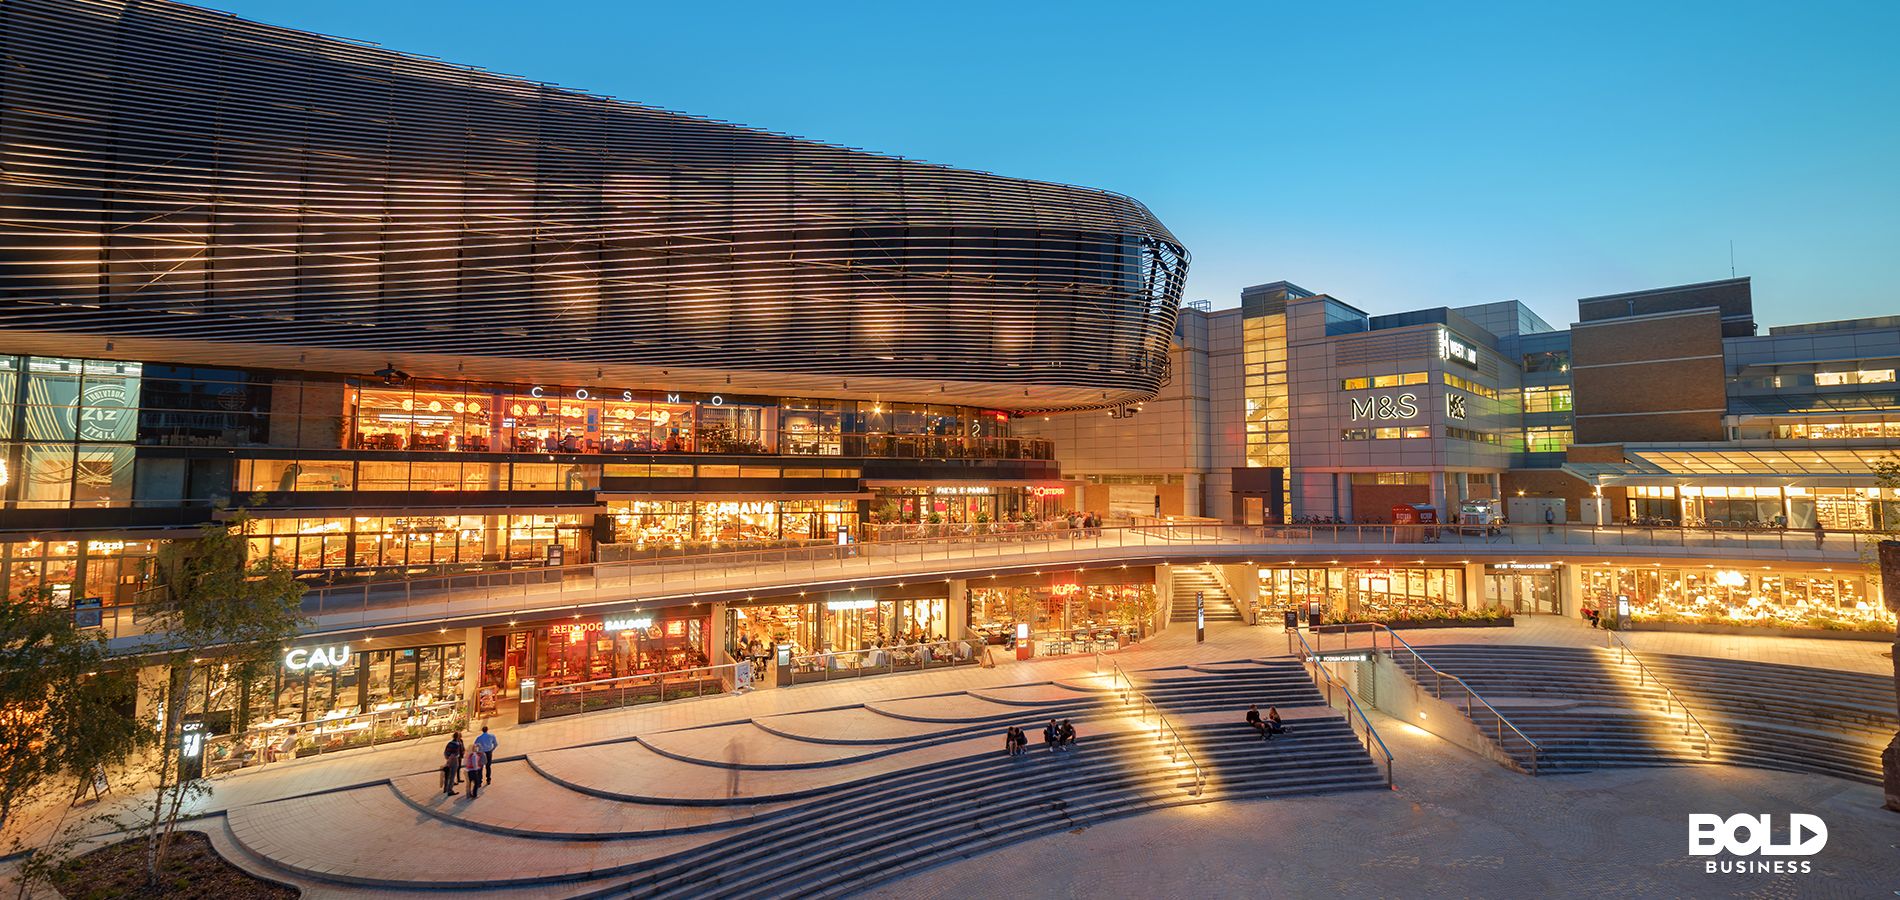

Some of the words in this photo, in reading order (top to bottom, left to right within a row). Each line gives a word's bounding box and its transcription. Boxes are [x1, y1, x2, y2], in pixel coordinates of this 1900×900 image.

[531, 386, 723, 406] COSMO
[1351, 393, 1418, 421] M&S
[706, 502, 774, 515] CABANA
[552, 624, 575, 634] RED
[580, 622, 603, 631] DOG
[285, 645, 350, 670] CAU
